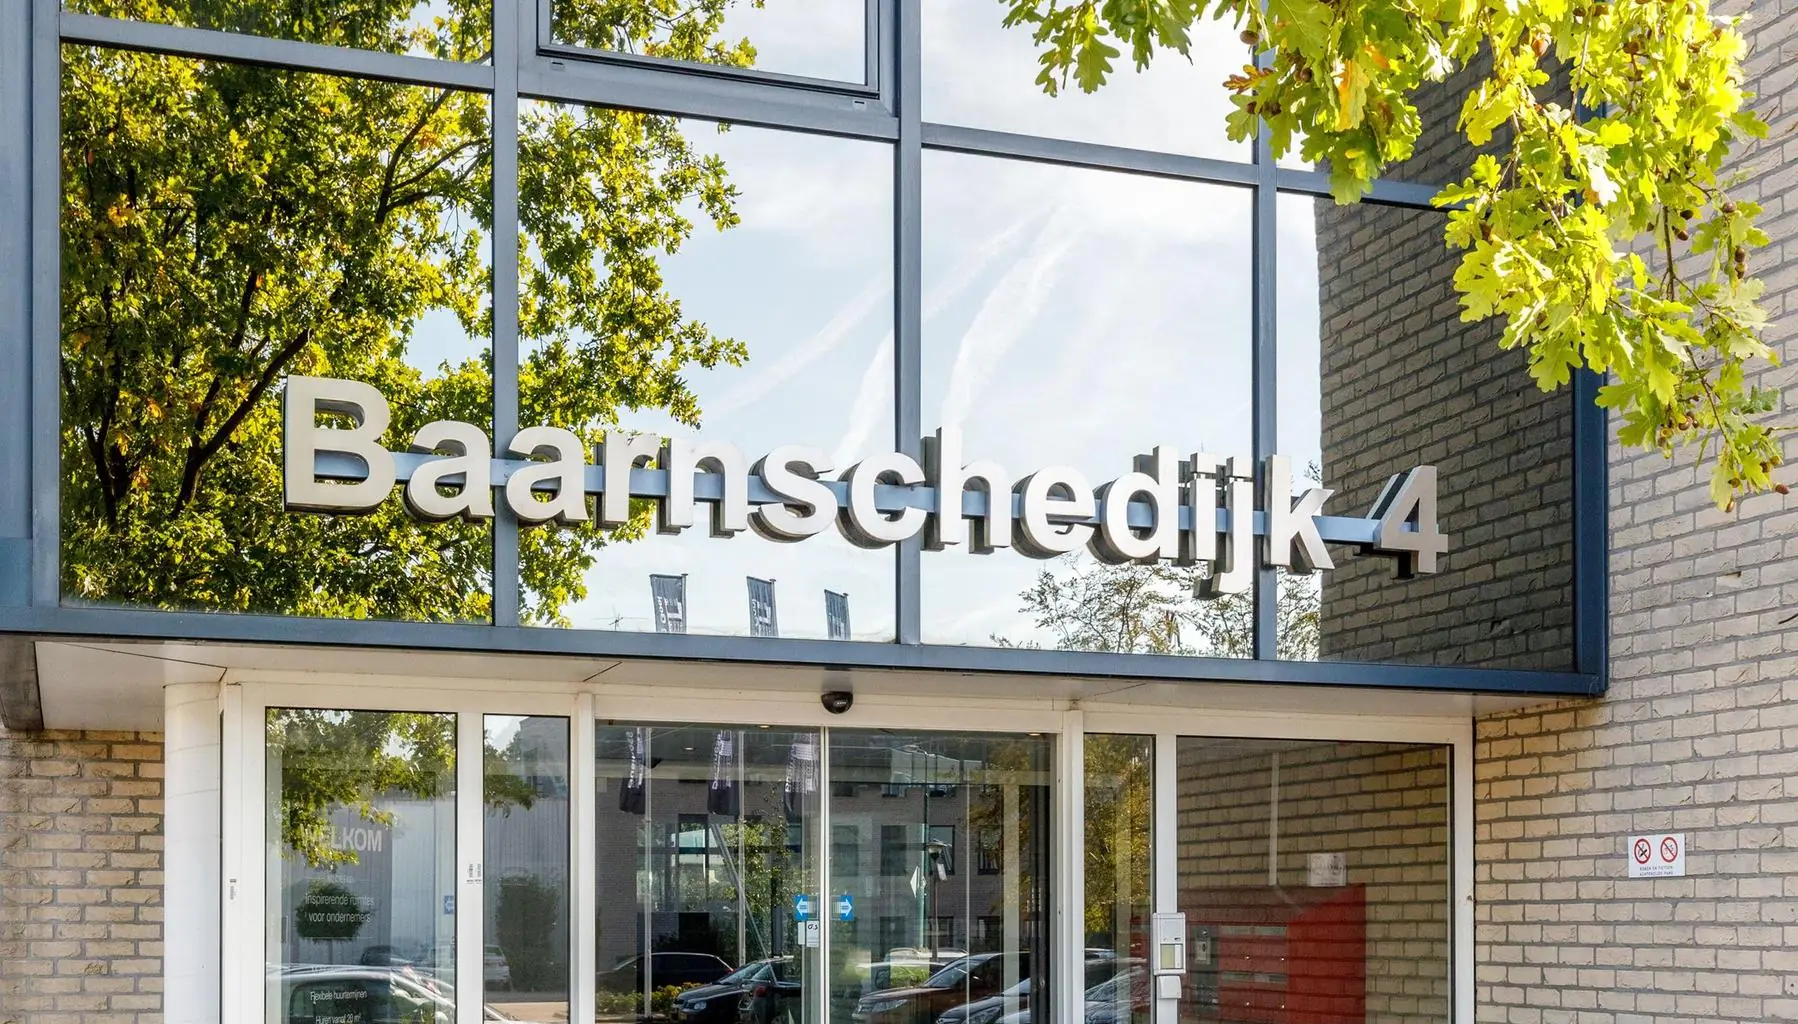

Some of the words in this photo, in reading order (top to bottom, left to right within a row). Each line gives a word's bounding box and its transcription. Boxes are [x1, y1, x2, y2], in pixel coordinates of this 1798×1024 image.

[285, 375, 1335, 594] Baarnschedijk
[1380, 464, 1449, 574] 4
[300, 823, 383, 852] WLKOM
[308, 912, 325, 922] voor
